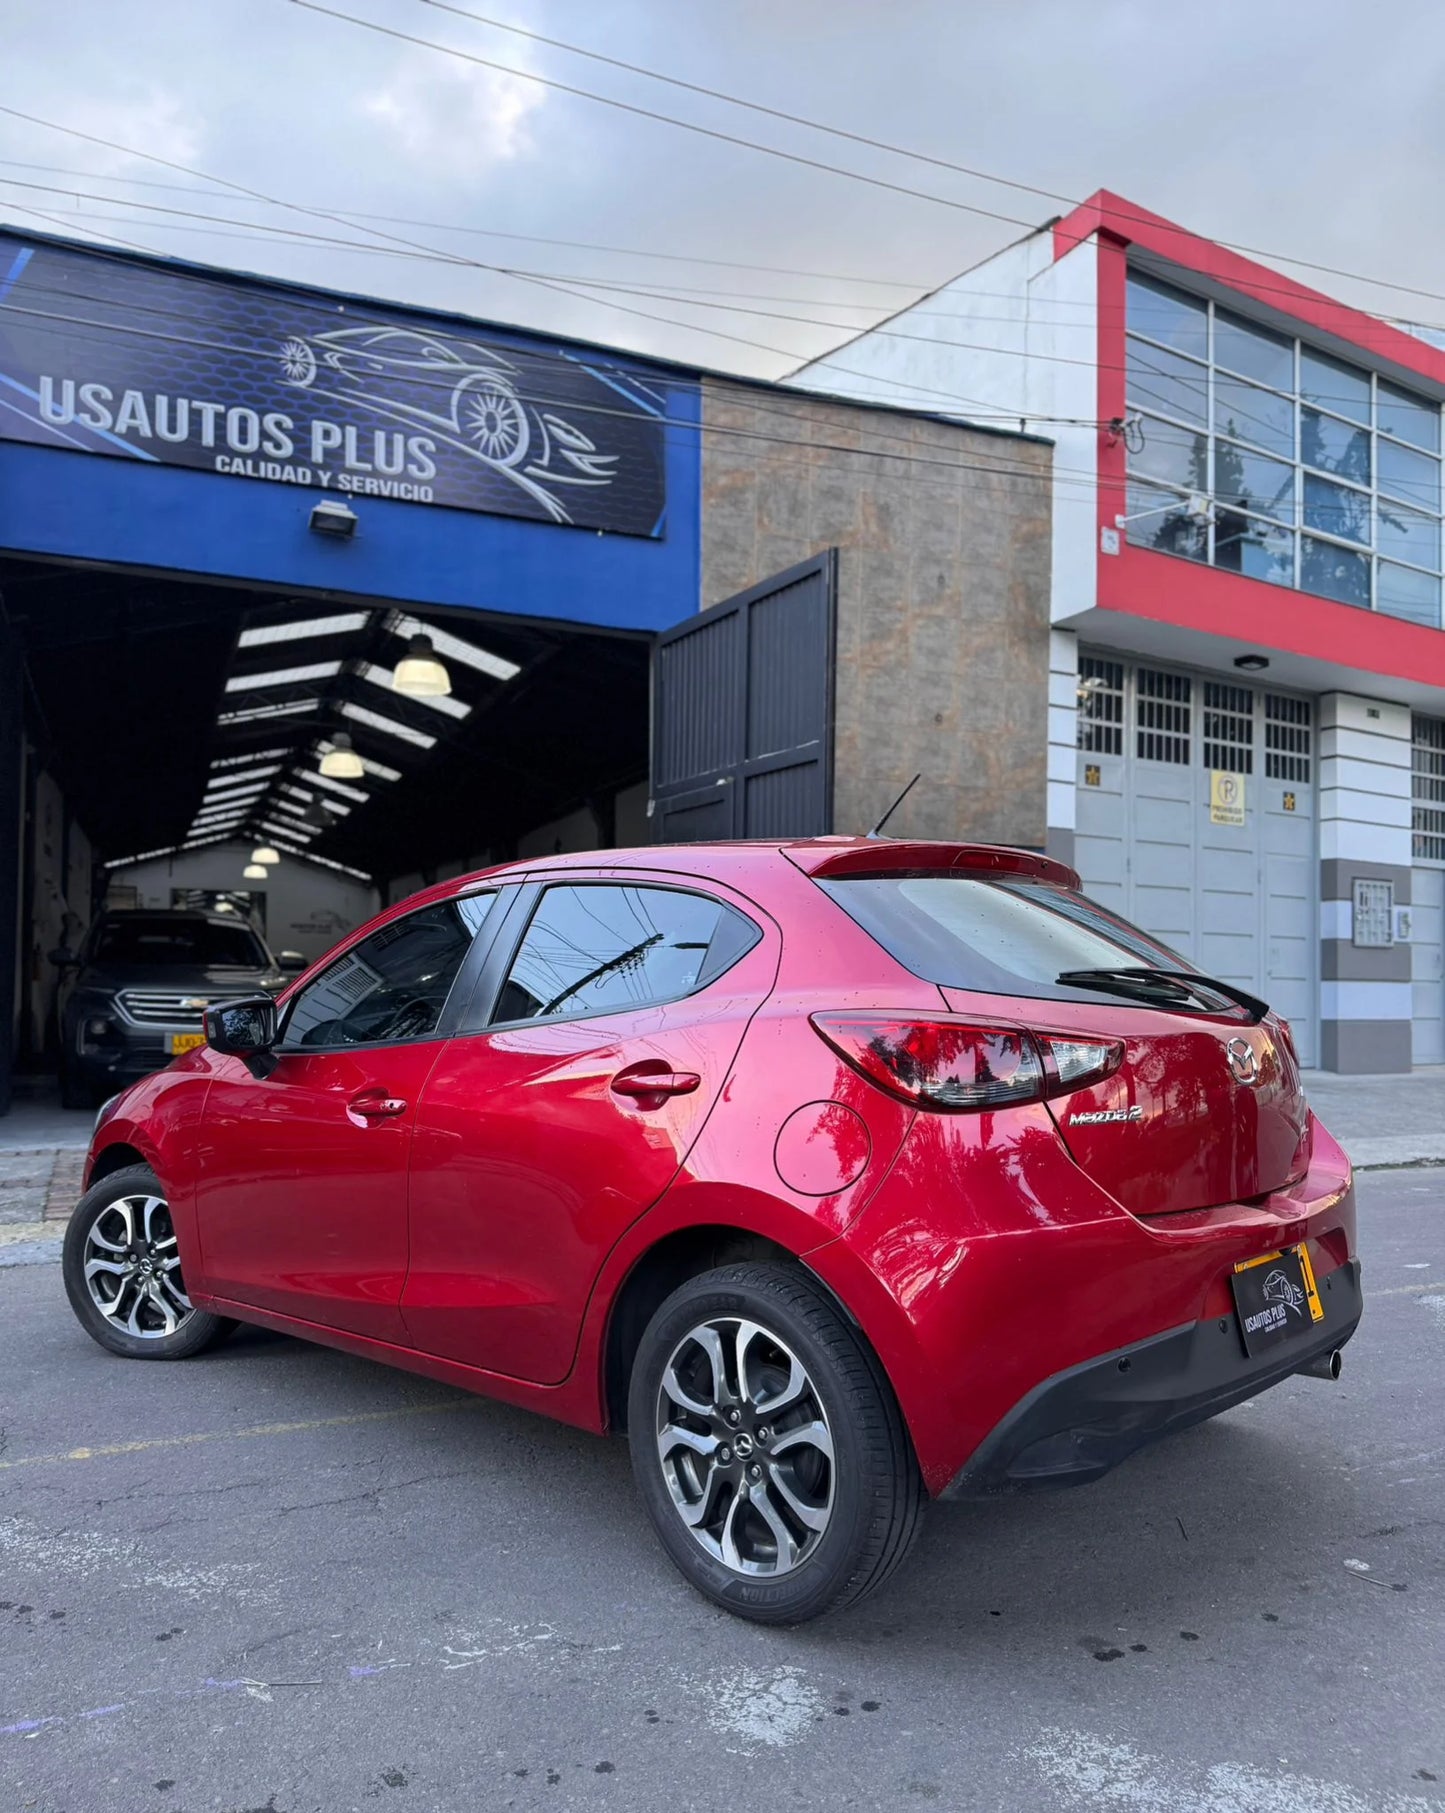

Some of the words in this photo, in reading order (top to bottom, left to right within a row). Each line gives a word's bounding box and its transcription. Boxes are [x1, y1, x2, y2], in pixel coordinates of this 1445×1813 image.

[39, 375, 294, 458] USAUTOS
[311, 420, 437, 480] PLUS
[215, 455, 312, 485] CALIDAD
[318, 471, 332, 487] Y
[337, 473, 433, 502] SERVICIO
[1270, 1303, 1286, 1321] PLUS
